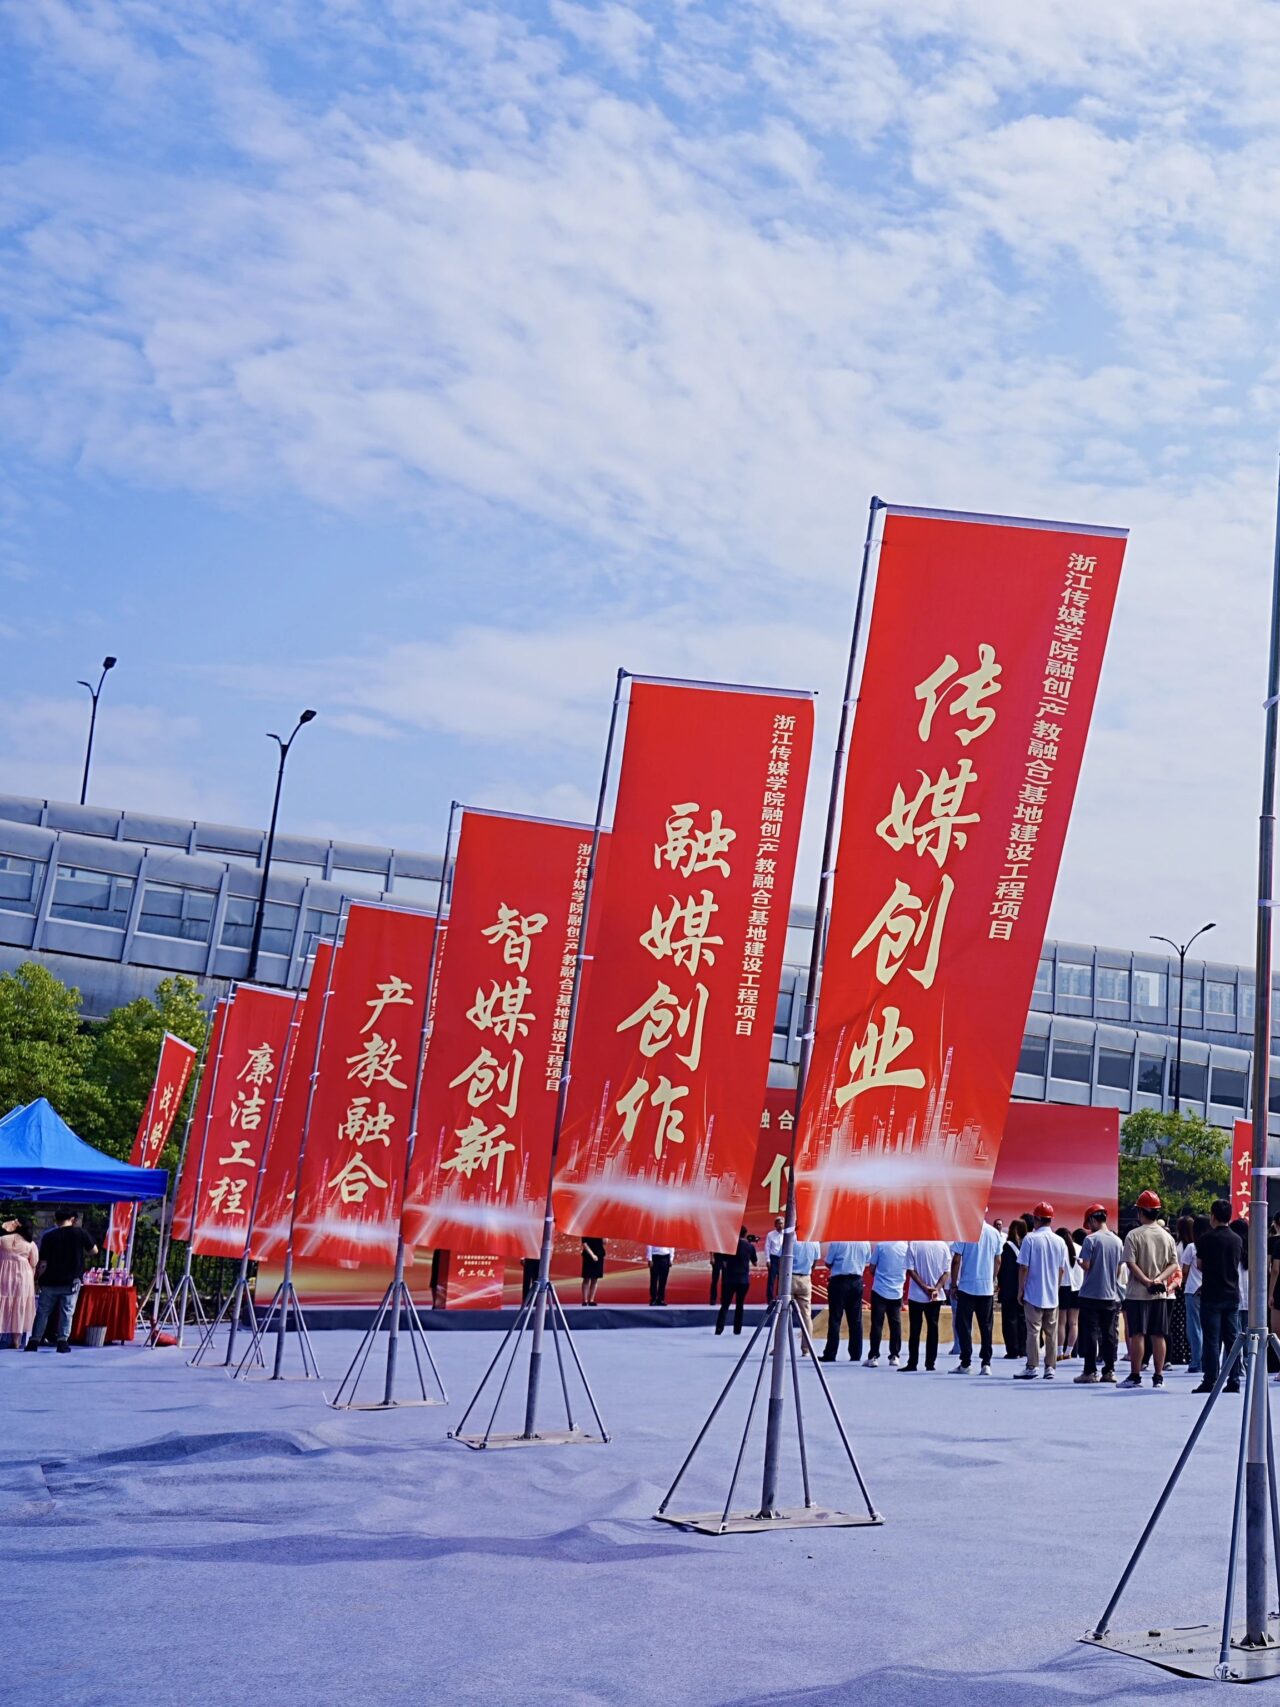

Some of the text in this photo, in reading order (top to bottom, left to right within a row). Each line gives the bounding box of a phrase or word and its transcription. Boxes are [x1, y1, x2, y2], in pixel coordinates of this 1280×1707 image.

[735, 714, 796, 1036] 浙江传媒学院融创（产教融合）基地建设工程项目
[835, 643, 1002, 1110] 传媒创业
[988, 552, 1098, 942] 浙江传媒学院融创（产教融合）基地建设工程项目
[209, 1042, 274, 1214] 廉洁工程
[328, 975, 414, 1203] 产教融合
[440, 902, 548, 1192] 智媒创新
[616, 802, 736, 1160] 融媒创作
